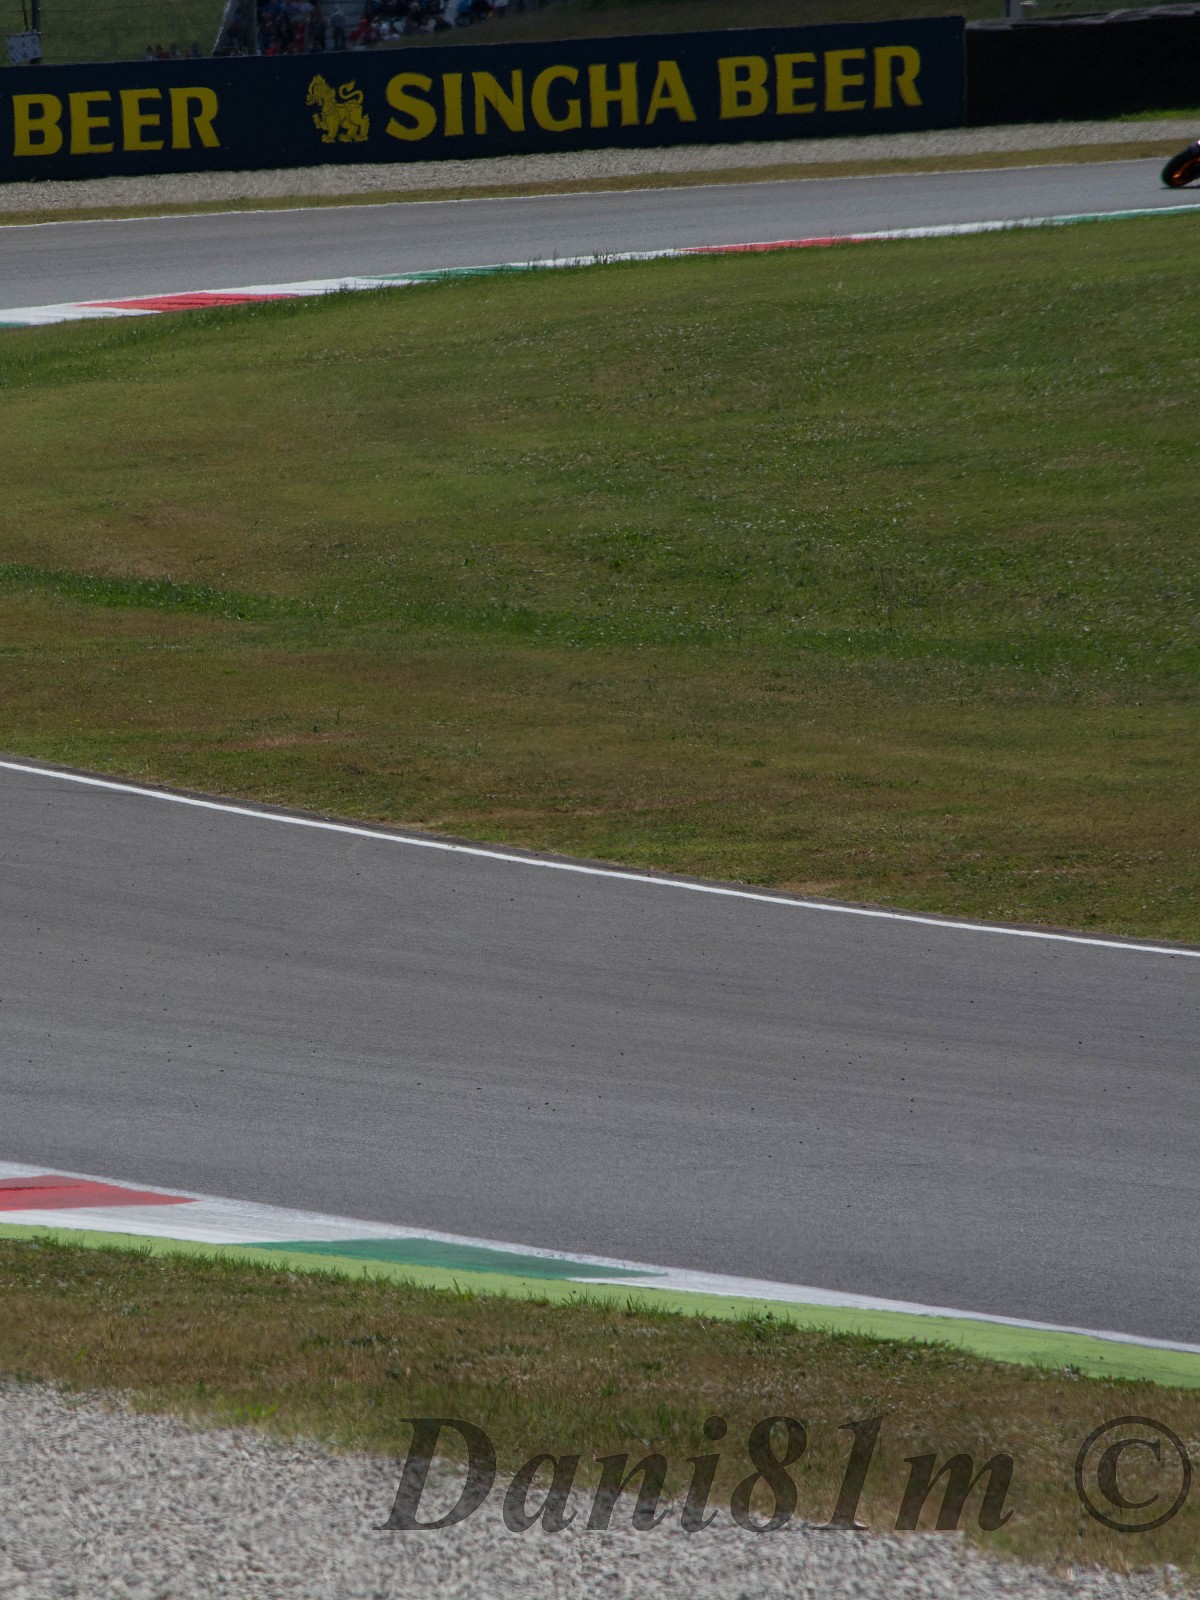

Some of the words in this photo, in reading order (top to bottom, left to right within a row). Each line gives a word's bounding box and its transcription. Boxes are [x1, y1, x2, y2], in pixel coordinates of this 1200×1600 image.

[13, 87, 220, 156] BEER
[386, 61, 695, 141] SINGHA
[718, 46, 921, 119] BEER
